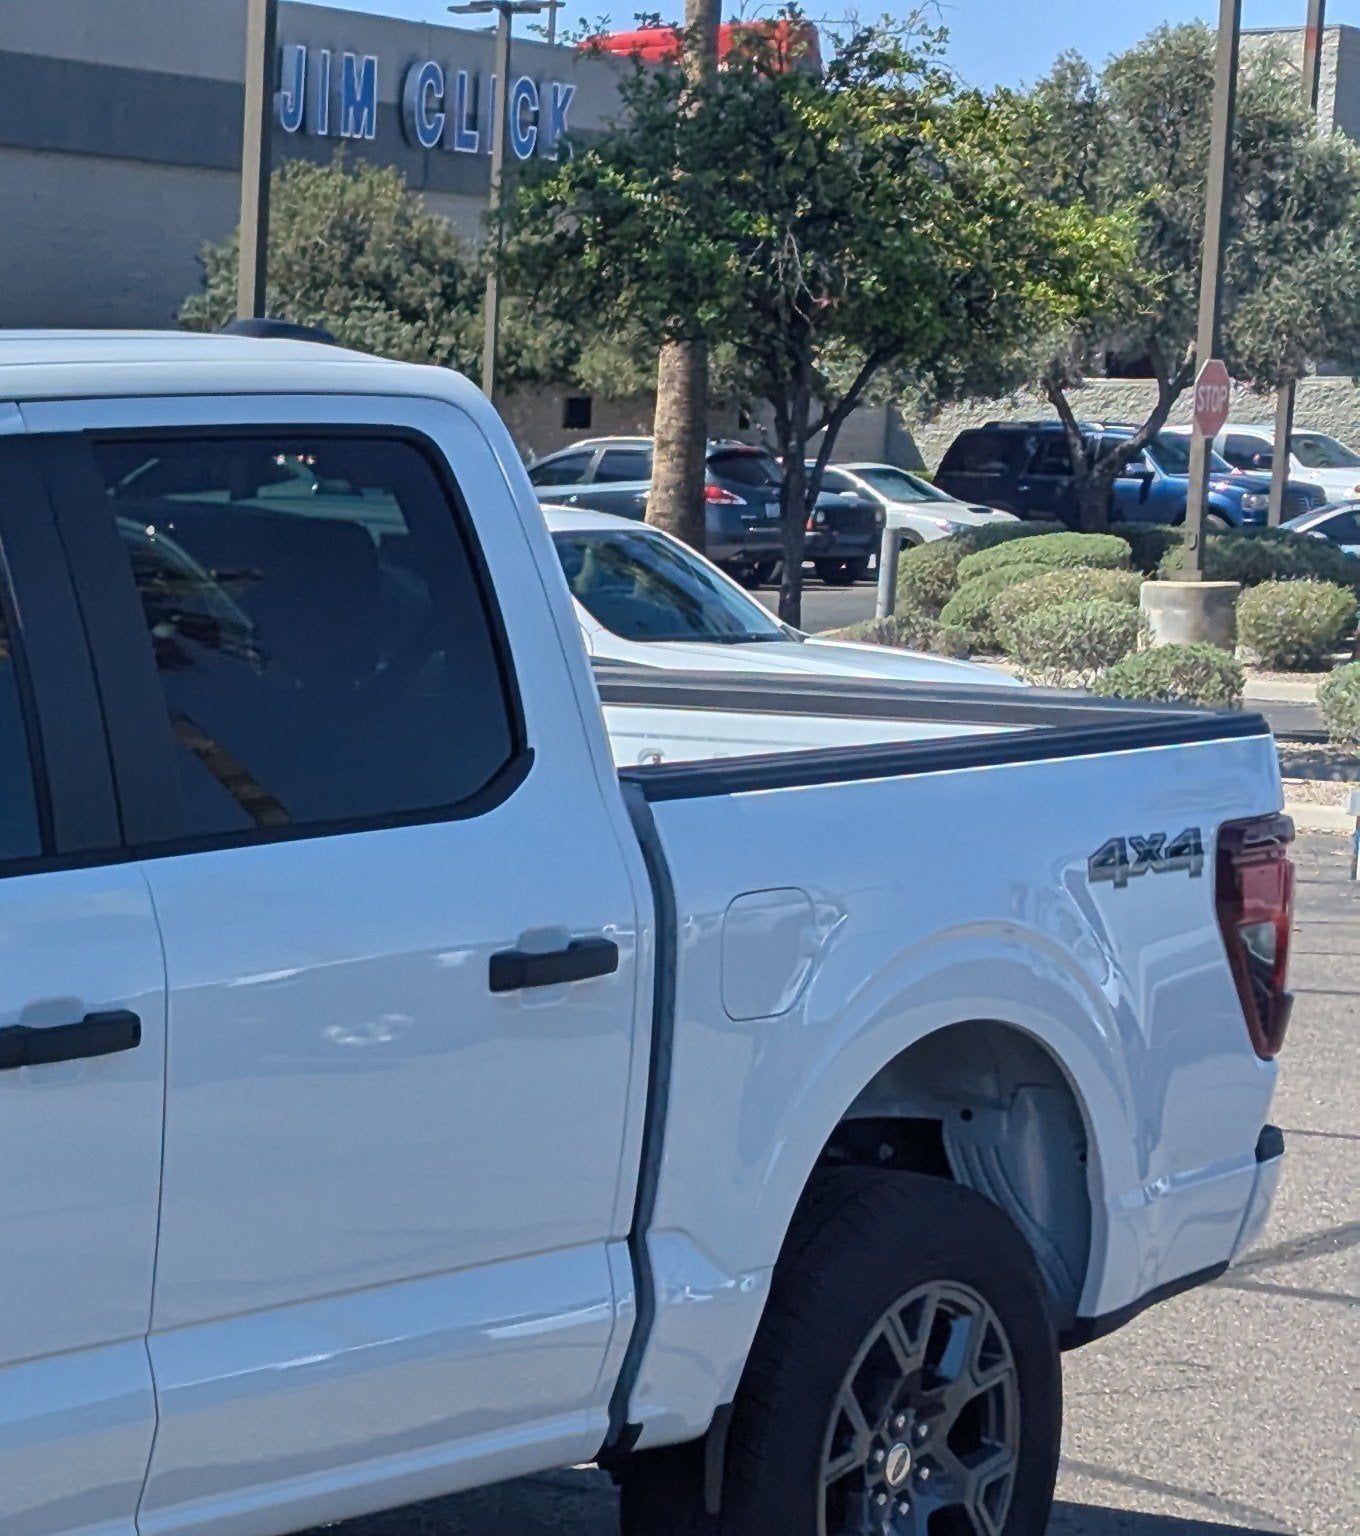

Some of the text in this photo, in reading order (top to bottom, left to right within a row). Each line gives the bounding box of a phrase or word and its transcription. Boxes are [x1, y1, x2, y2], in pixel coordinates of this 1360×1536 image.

[276, 45, 578, 160] JIM CLICK
[1197, 385, 1228, 413] STOP
